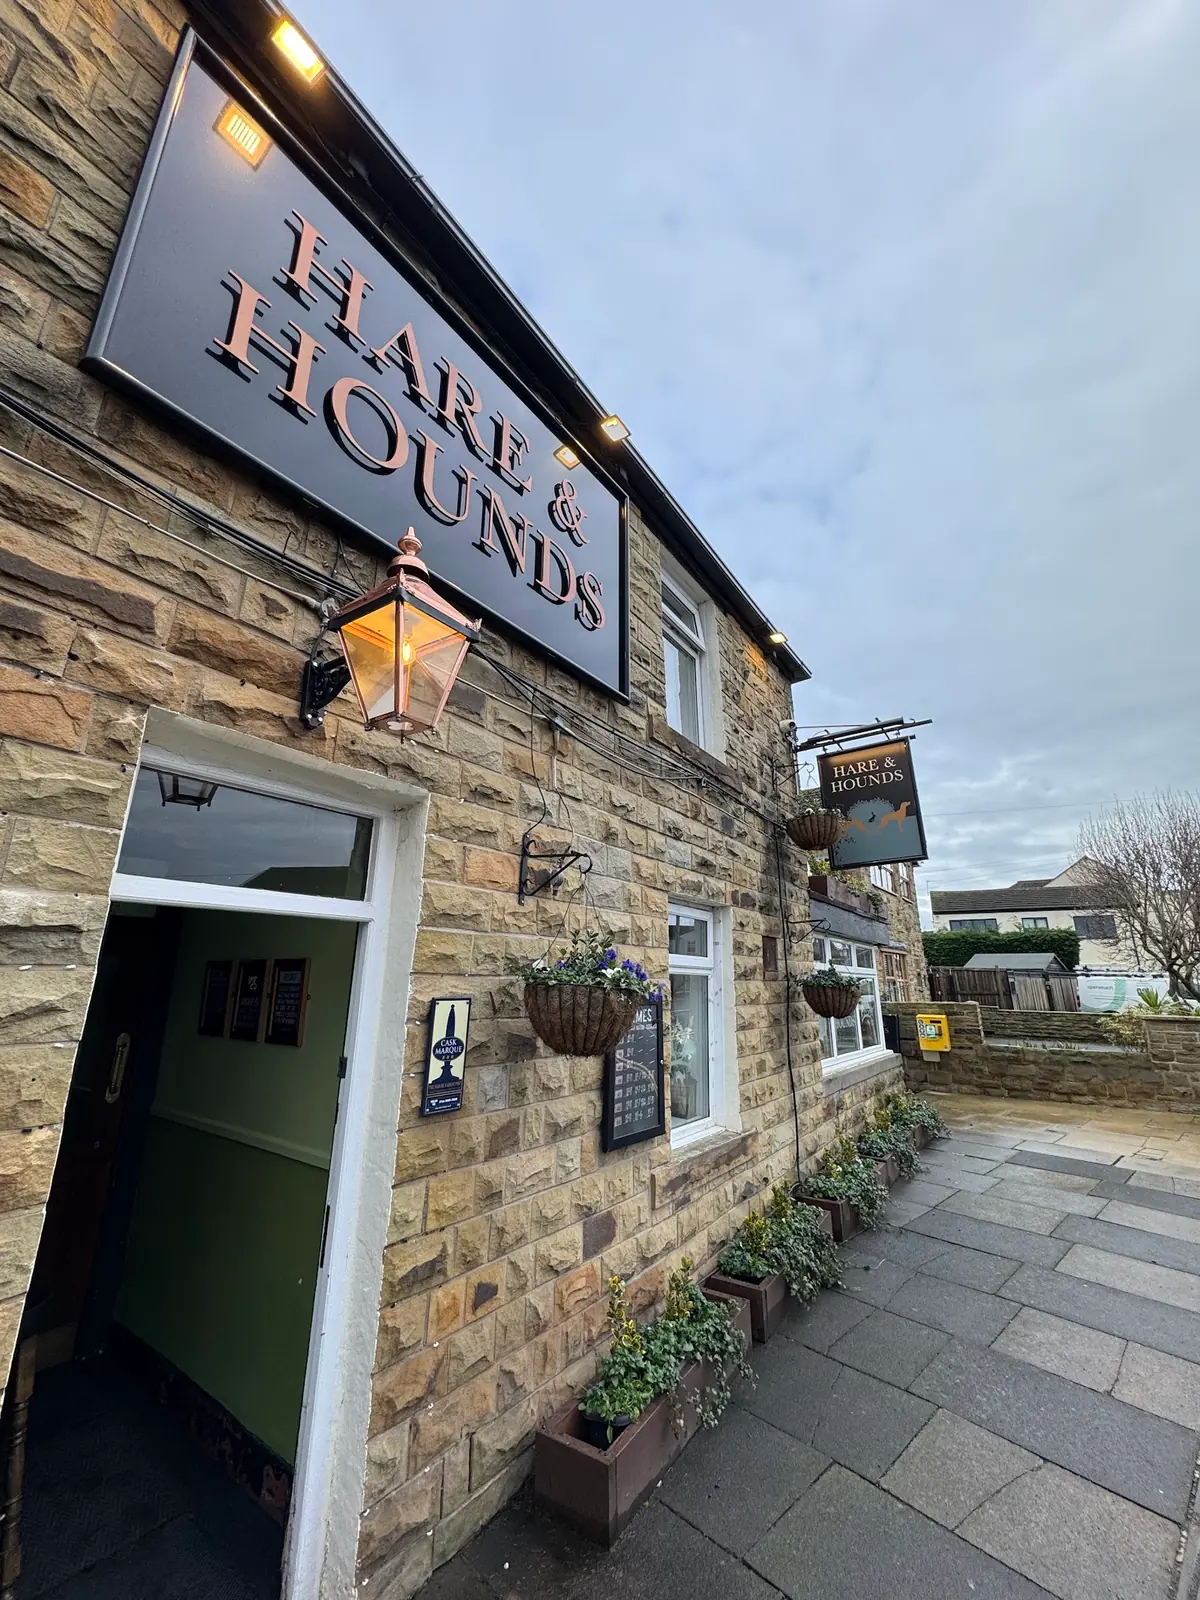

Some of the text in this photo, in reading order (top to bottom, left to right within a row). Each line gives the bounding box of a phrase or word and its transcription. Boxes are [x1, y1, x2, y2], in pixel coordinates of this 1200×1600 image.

[277, 208, 588, 544] HARE &
[210, 269, 606, 629] HOUNDS
[833, 756, 897, 778] HARE &
[831, 769, 904, 793] HOUNDS
[434, 1045, 462, 1055] MARQUE
[440, 1039, 457, 1047] CASK
